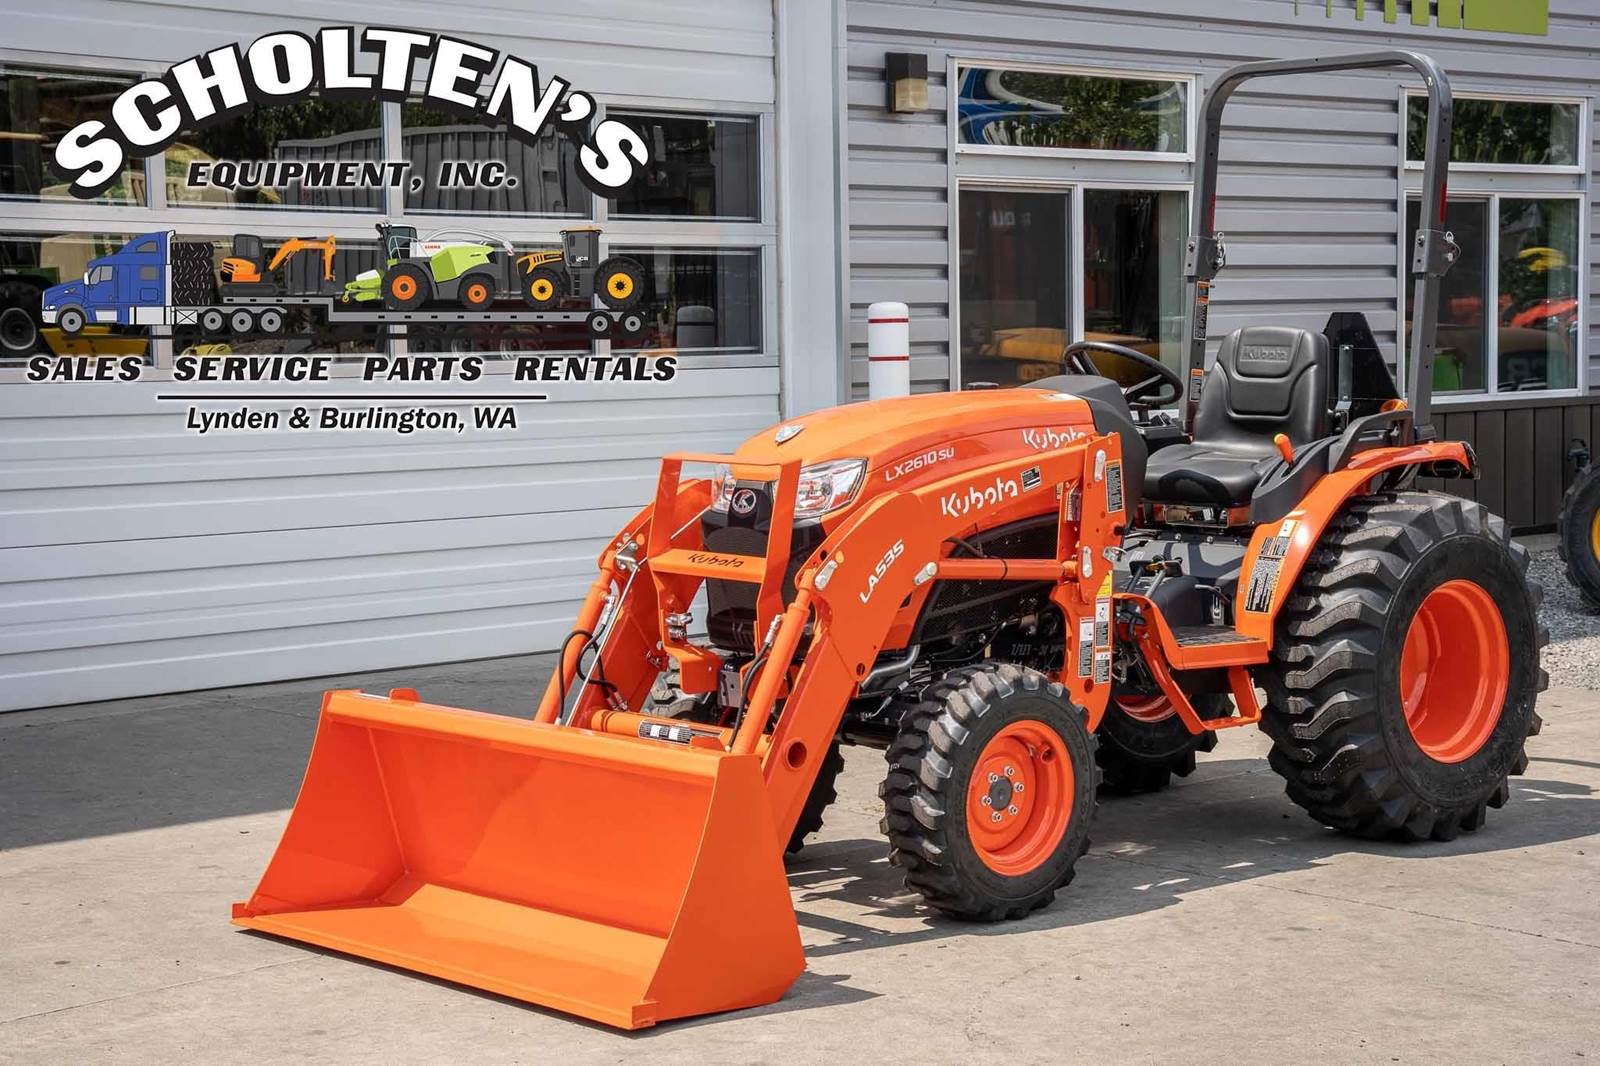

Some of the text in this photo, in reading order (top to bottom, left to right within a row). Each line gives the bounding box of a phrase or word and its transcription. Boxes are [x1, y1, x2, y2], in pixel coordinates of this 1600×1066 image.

[941, 477, 1018, 518] Kubota
[688, 553, 744, 568] Kubota
[859, 539, 905, 604] LA535
